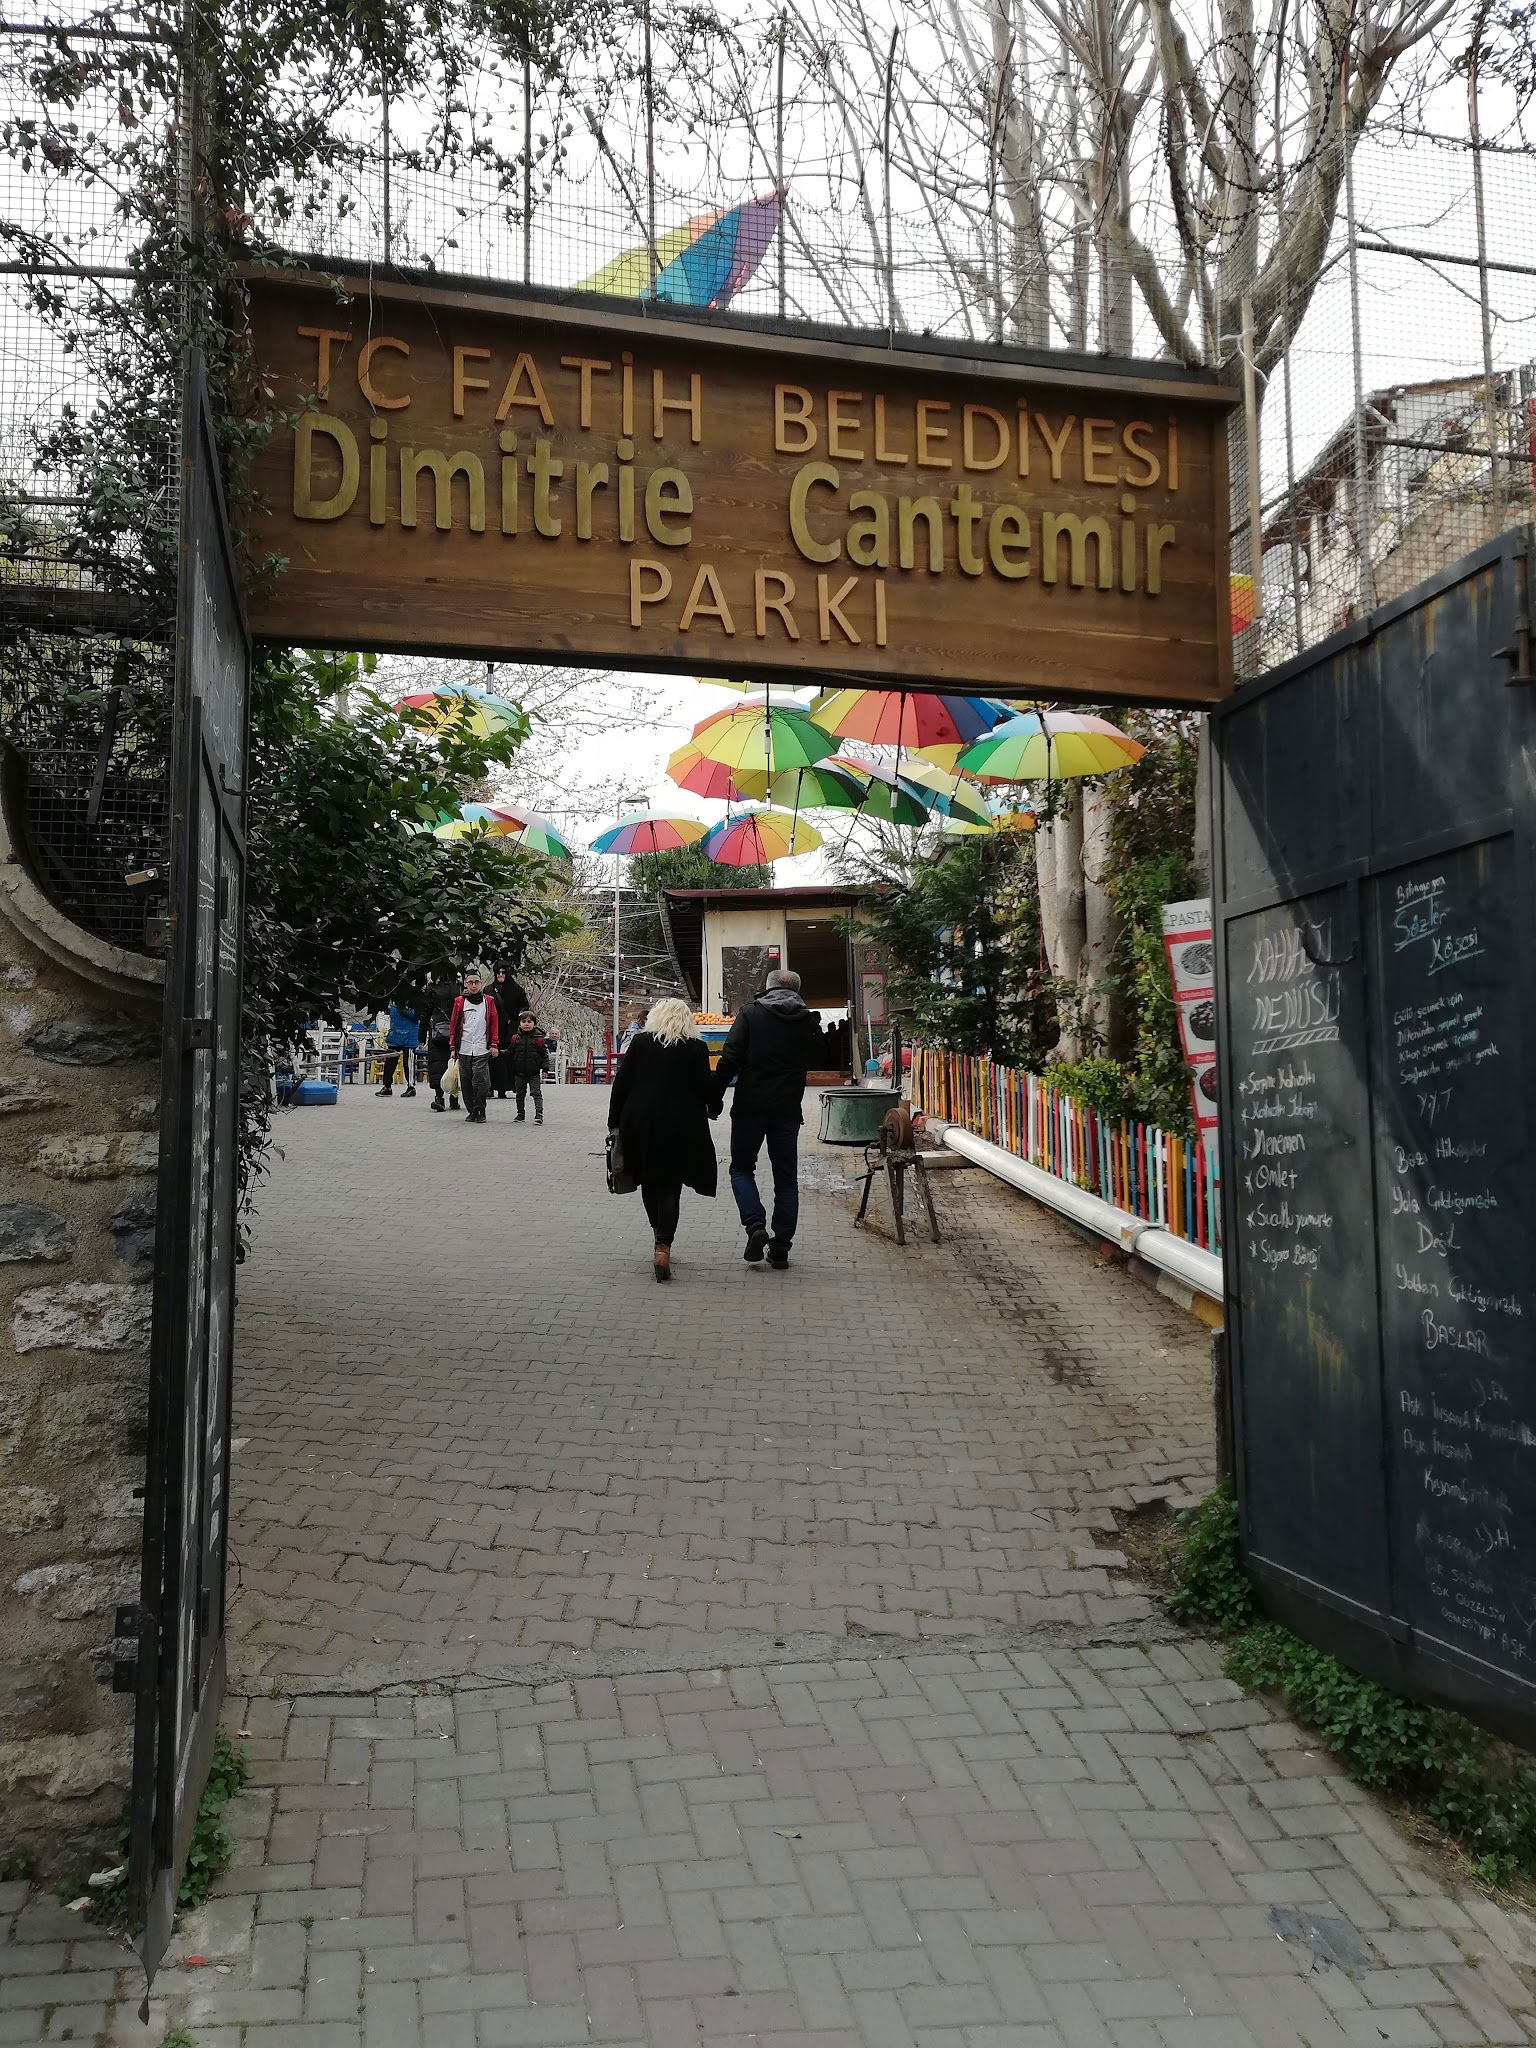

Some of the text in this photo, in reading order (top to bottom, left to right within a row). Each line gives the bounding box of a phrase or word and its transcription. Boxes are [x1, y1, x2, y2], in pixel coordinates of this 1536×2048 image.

[298, 327, 1180, 491] TC FATİH BELEDİYESİ
[293, 413, 1175, 595] Dimitrie Cantemir
[630, 559, 887, 647] PARKI
[1255, 1160, 1299, 1190] Omlet
